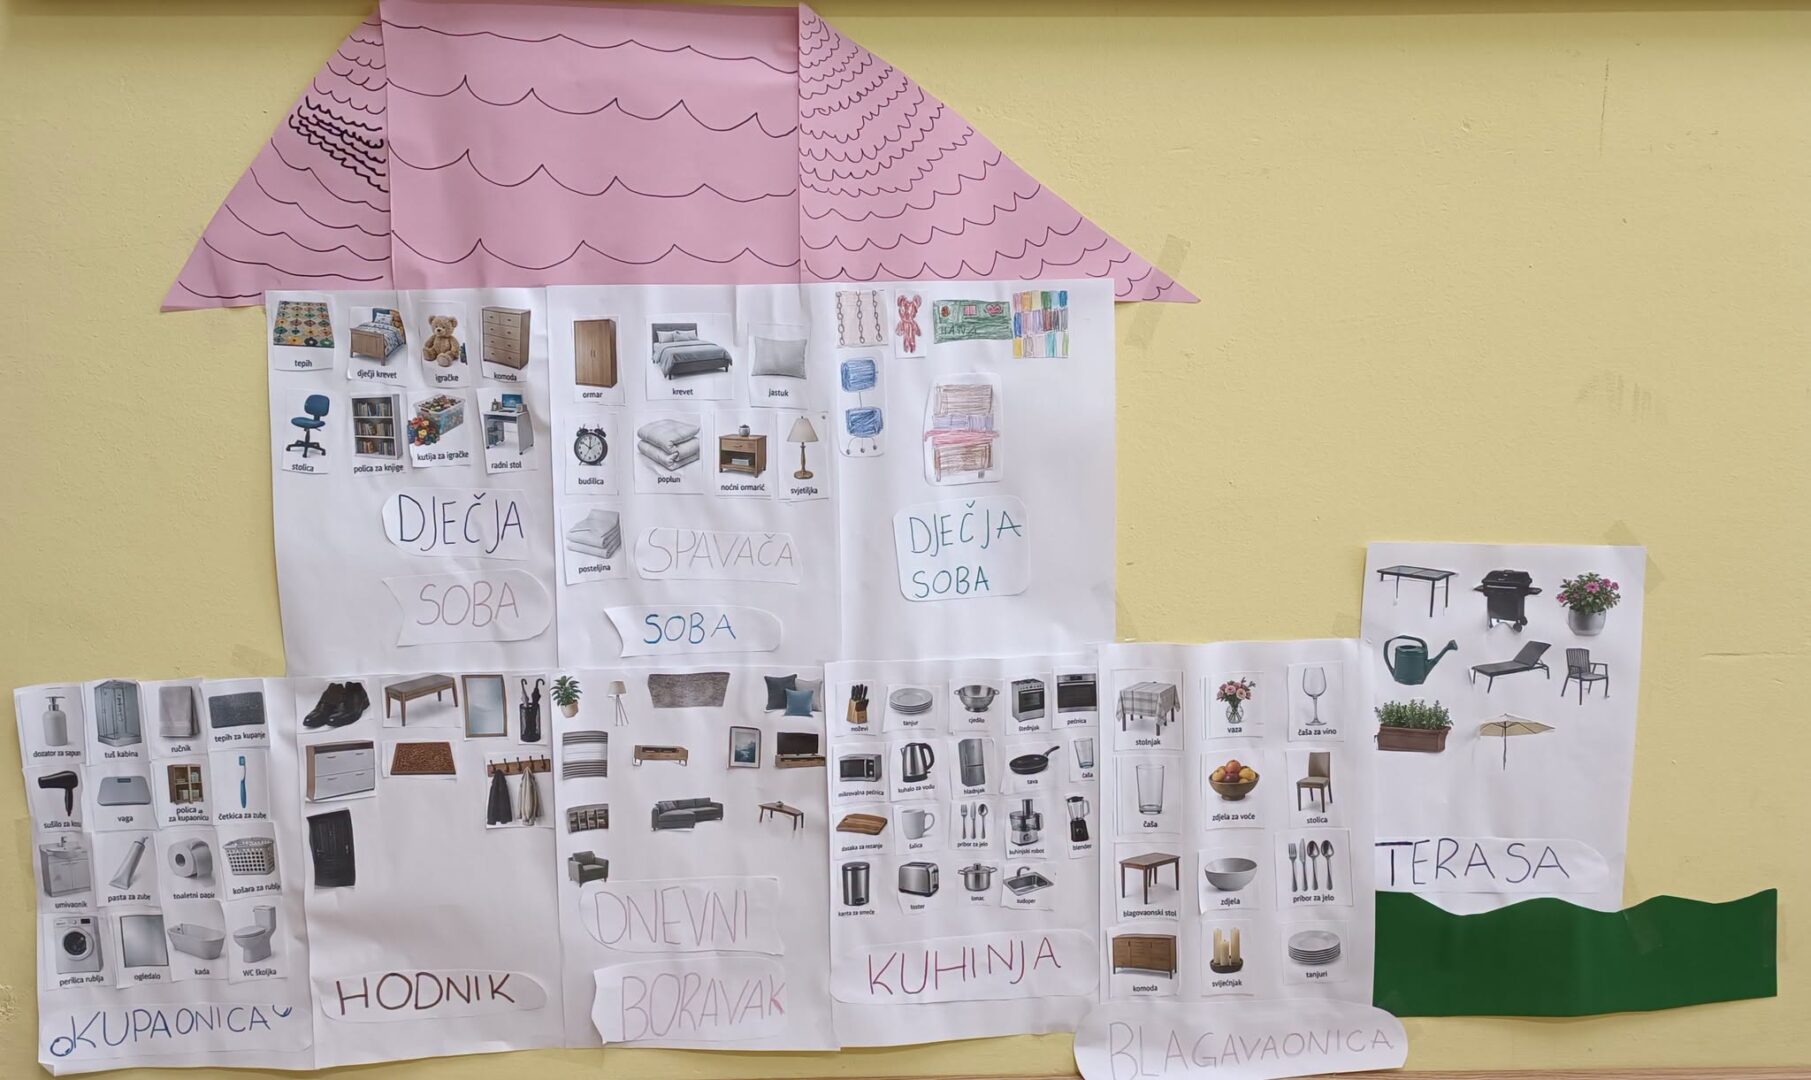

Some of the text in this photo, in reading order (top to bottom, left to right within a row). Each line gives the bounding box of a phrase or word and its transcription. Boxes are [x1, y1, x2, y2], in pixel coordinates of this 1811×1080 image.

[294, 359, 312, 369] tepih
[357, 369, 397, 380] dječji krevet
[435, 373, 459, 384] igračke
[493, 372, 517, 382] komoda
[582, 391, 603, 399] ormar
[672, 388, 693, 396] krevet
[768, 388, 789, 397] jastuk
[417, 452, 436, 462] kutija
[446, 451, 469, 461] igračke
[291, 463, 314, 472] stolica
[353, 465, 373, 474] polica
[384, 464, 404, 474] knjige
[491, 461, 522, 470] radni stol
[578, 477, 604, 486] budilica
[657, 475, 681, 485] poplun
[720, 482, 765, 491] noćni ormarić
[790, 486, 818, 496] svjetiljka
[399, 492, 524, 554] DJEČJA
[909, 500, 1022, 557] DJEČJA
[642, 527, 794, 573] SPAVAČA
[578, 563, 611, 574] posteljina
[912, 566, 990, 599] SOBA
[416, 581, 519, 627] SOBA
[643, 612, 736, 645] SOBA
[214, 734, 233, 743] tepih
[243, 731, 266, 740] kupanje
[1298, 728, 1312, 736] čaša
[1135, 738, 1161, 748] stolnjak
[33, 750, 56, 758] dozator
[104, 750, 139, 758] tuš kabina
[171, 745, 192, 753] ručnik
[964, 787, 985, 795] hladnjak
[176, 806, 197, 815] polica
[218, 812, 243, 820] četkica
[253, 811, 267, 819] zube
[117, 815, 134, 823] vaga
[177, 814, 209, 823] kupaonicu
[1212, 813, 1230, 822] zdjela
[1240, 812, 1256, 820] voće
[1306, 816, 1328, 824] stolica
[44, 820, 62, 829] sušilo
[1143, 820, 1158, 828] čaša
[1072, 843, 1092, 851] blender
[1375, 838, 1570, 887] TERASA
[232, 885, 255, 895] košara
[108, 895, 127, 903] pasta
[173, 892, 198, 900] toaletni
[1293, 894, 1312, 904] pribor
[1322, 893, 1335, 903] jelo
[55, 901, 87, 909] umivaonik
[1220, 897, 1241, 907] zdjela
[594, 885, 748, 946] DNEVNI
[1123, 909, 1177, 919] blagovaonski stol
[868, 937, 1062, 996] KUHINJA
[134, 972, 161, 982] ogledalo
[194, 968, 210, 976] kada
[242, 968, 277, 977] WC školjka
[1305, 970, 1328, 979] tanjuri
[59, 976, 104, 987] perilica rublja
[1132, 984, 1158, 992] komoda
[335, 972, 515, 1016] HODNIK
[621, 972, 785, 1041] BORAVAK
[71, 1006, 271, 1049] KUPAONICA
[1109, 1021, 1394, 1080] BLAGAVAONICA
